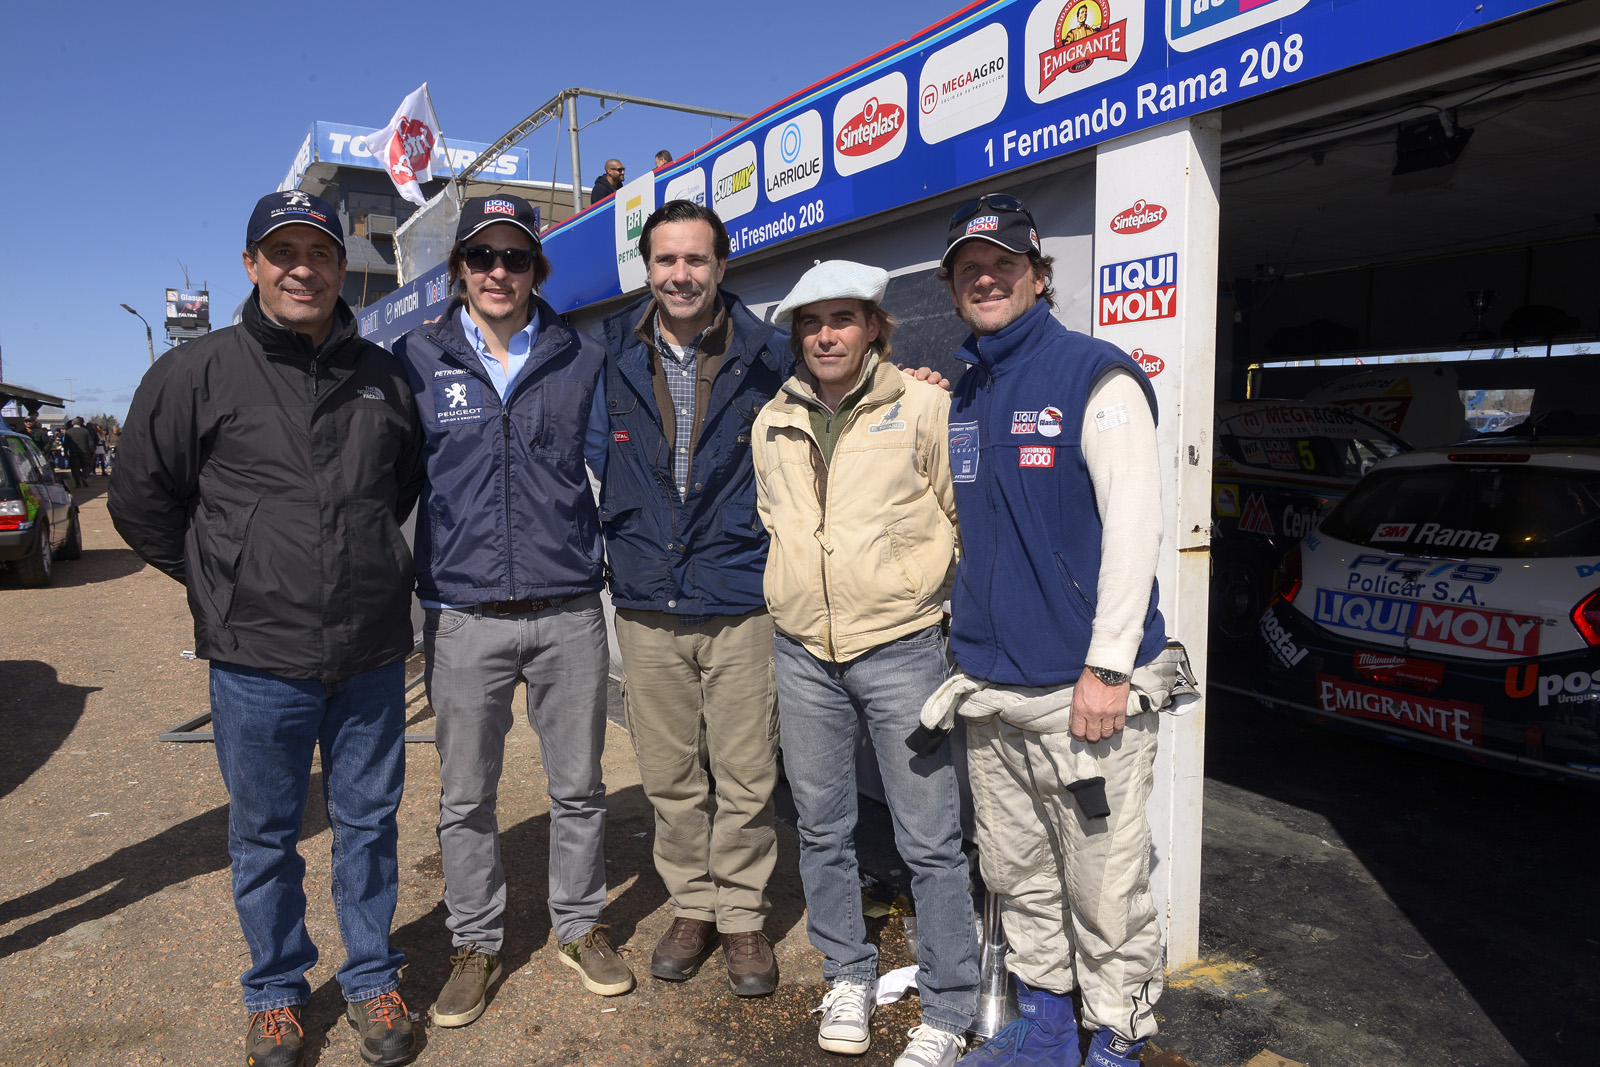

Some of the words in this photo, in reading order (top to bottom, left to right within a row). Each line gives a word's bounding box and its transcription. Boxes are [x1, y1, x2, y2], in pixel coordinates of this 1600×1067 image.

[1043, 28, 1120, 80] EMIGRANTE
[941, 56, 1005, 95] MEGAAGRO
[984, 138, 994, 168] 1
[1003, 98, 1127, 162] Fernando
[1137, 67, 1227, 120] Rama
[1239, 33, 1304, 88] 208
[839, 107, 900, 152] Sinteplast
[714, 162, 755, 203] SUBWAY
[766, 157, 820, 192] LARRIQUE
[486, 199, 514, 209] LIQUI
[486, 205, 513, 214] MOLY
[628, 211, 642, 231] BR
[741, 212, 796, 249] Fresnedo
[799, 199, 825, 229] 208
[968, 222, 997, 233] MOLY
[1113, 206, 1164, 231] Sinteplast
[1103, 255, 1174, 294] LIQUI
[393, 291, 419, 319] HYUNDAI
[1102, 287, 1175, 323] MOLY
[437, 408, 482, 418] PEUGEOT
[1014, 413, 1037, 423] LIQUI
[1266, 405, 1354, 425] MEGAAGRO
[1014, 423, 1035, 432] MOLY
[1020, 453, 1051, 465] 2000
[1241, 441, 1261, 454] WIX
[1266, 450, 1297, 464] MOLY
[1296, 440, 1316, 471] 5
[1378, 526, 1409, 538] 3M
[1414, 523, 1501, 551] Rama
[1347, 573, 1426, 598] Policar
[1432, 581, 1485, 606] S.A.
[1317, 591, 1412, 634] LIQUI
[1415, 605, 1536, 652] MOLY
[1358, 652, 1406, 665] Milwaukee
[1320, 681, 1474, 746] EMIGRANTE
